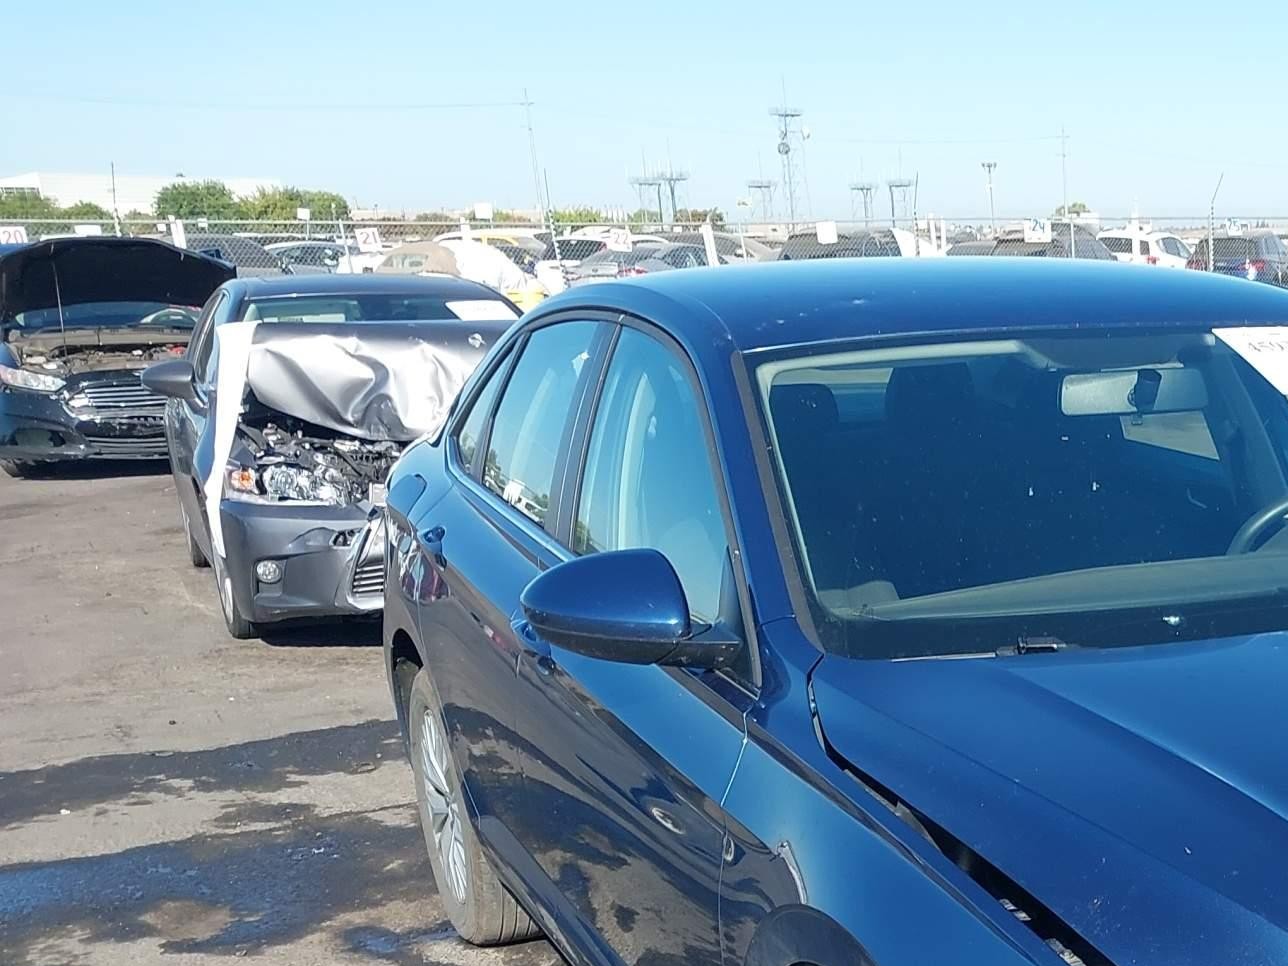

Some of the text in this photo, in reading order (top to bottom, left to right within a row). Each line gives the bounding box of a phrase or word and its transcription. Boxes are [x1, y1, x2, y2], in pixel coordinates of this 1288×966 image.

[2, 229, 24, 245] 20
[359, 231, 378, 245] 21
[613, 231, 630, 246] 22
